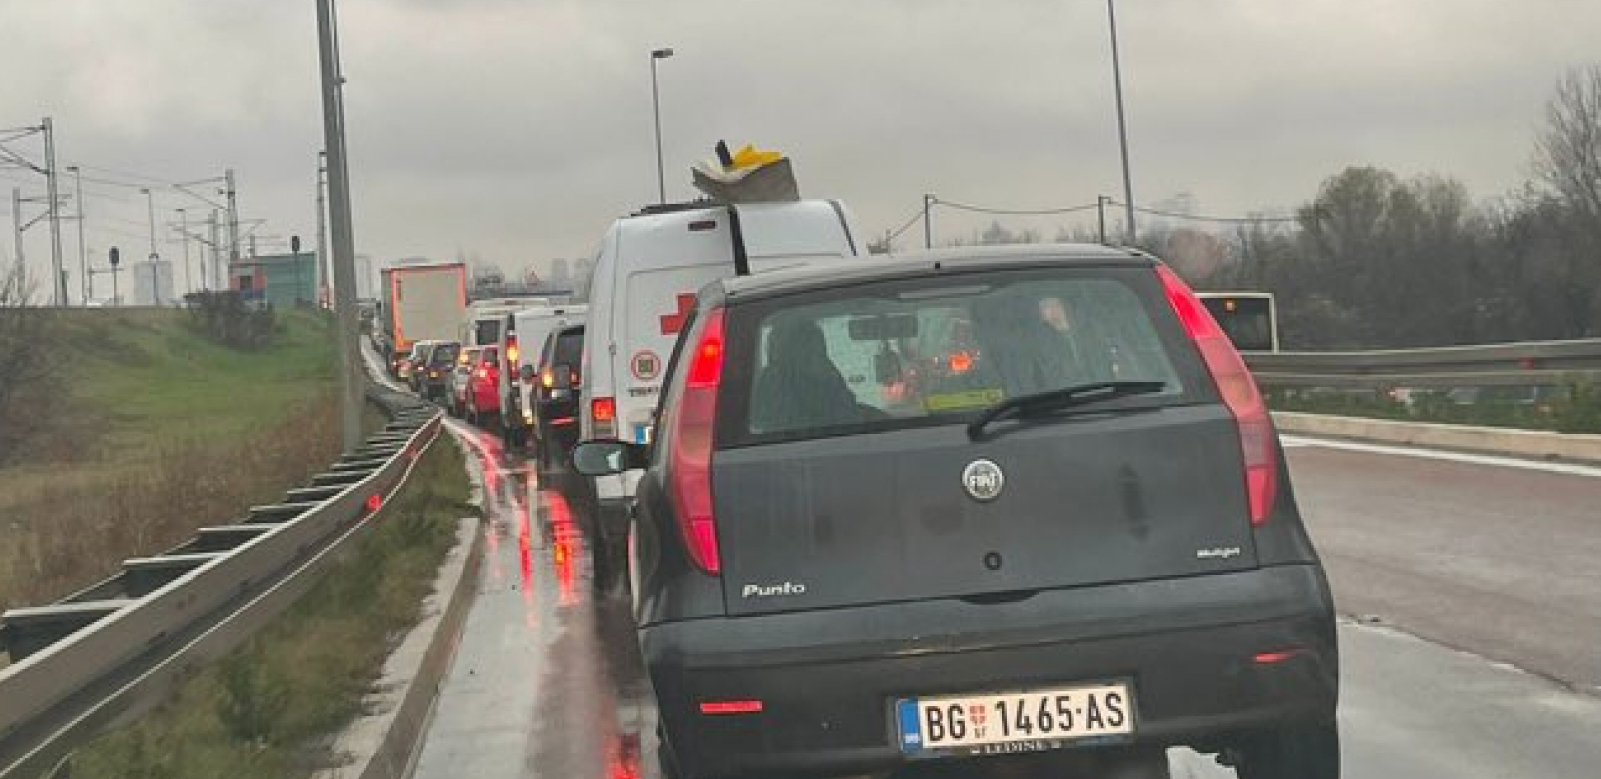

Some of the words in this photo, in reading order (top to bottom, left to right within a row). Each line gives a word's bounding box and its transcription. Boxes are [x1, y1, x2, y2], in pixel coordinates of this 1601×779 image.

[970, 473, 996, 488] FIAT
[742, 581, 806, 598] Punto
[925, 704, 966, 741] BG
